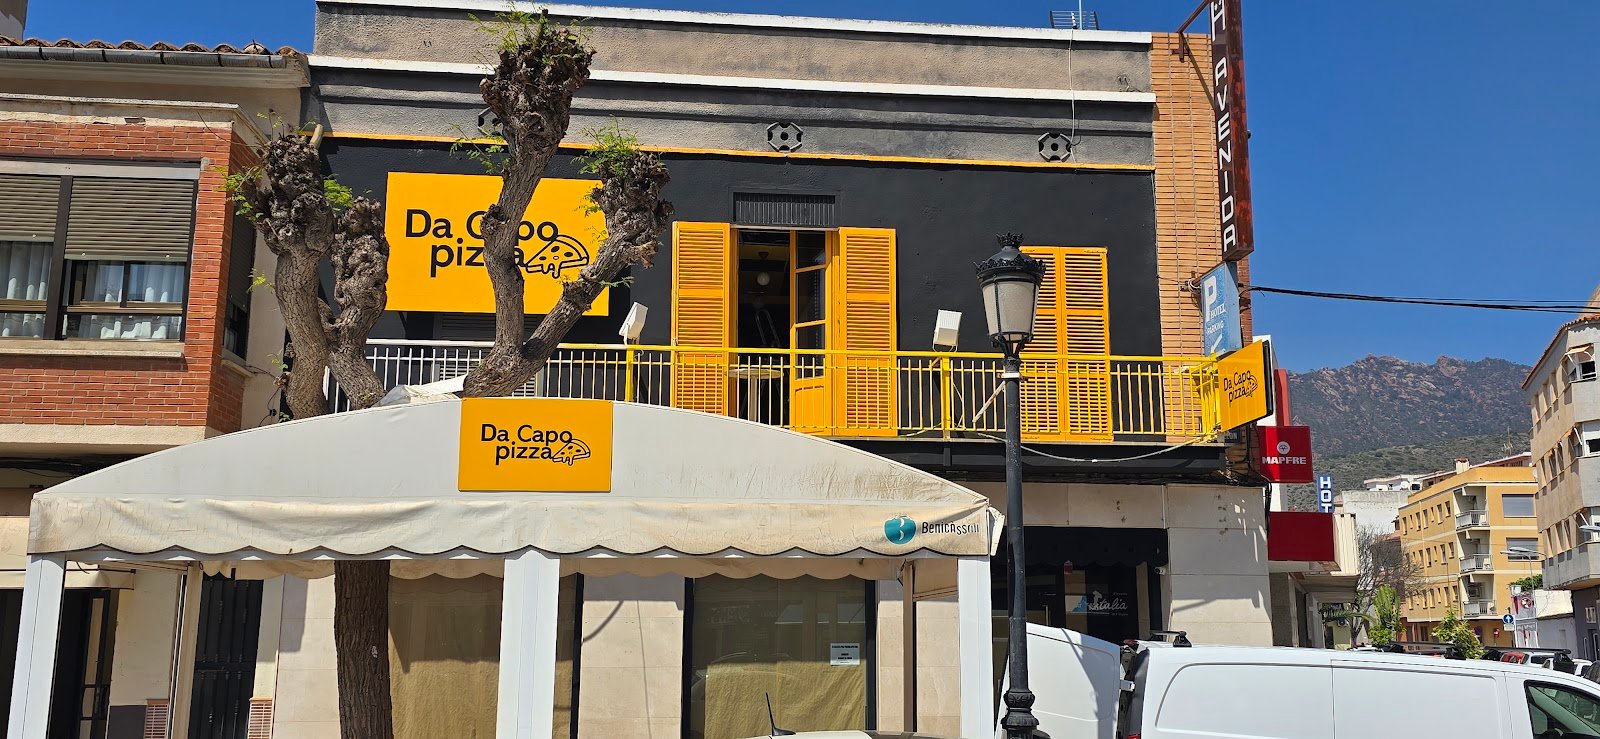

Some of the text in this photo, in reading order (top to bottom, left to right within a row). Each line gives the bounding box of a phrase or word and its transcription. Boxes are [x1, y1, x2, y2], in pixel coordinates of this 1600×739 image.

[1214, 57, 1236, 252] AVENIDA
[405, 209, 559, 242] Da Cpo
[430, 237, 526, 278] piza
[1204, 275, 1217, 322] P
[1224, 370, 1251, 391] Da Capo
[1229, 386, 1247, 404] pizza
[481, 423, 573, 446] Da Capo
[495, 441, 553, 465] pizza
[1261, 456, 1307, 465] MAPFRE
